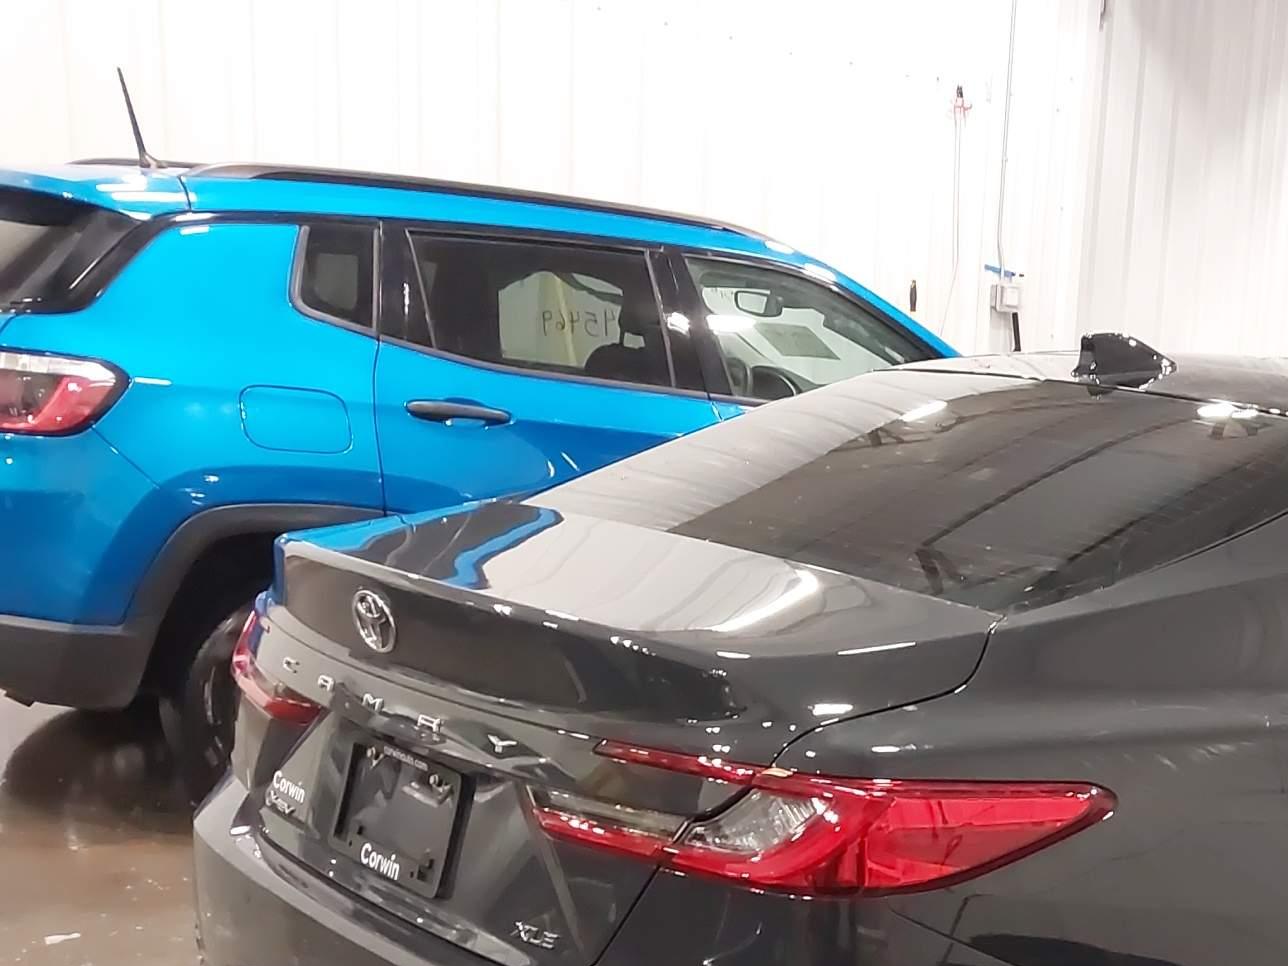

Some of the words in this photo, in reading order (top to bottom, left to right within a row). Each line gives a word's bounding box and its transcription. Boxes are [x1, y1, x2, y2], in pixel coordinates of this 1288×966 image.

[282, 656, 518, 754] CAMRY
[273, 770, 305, 803] Corwin
[360, 842, 400, 881] Corwin
